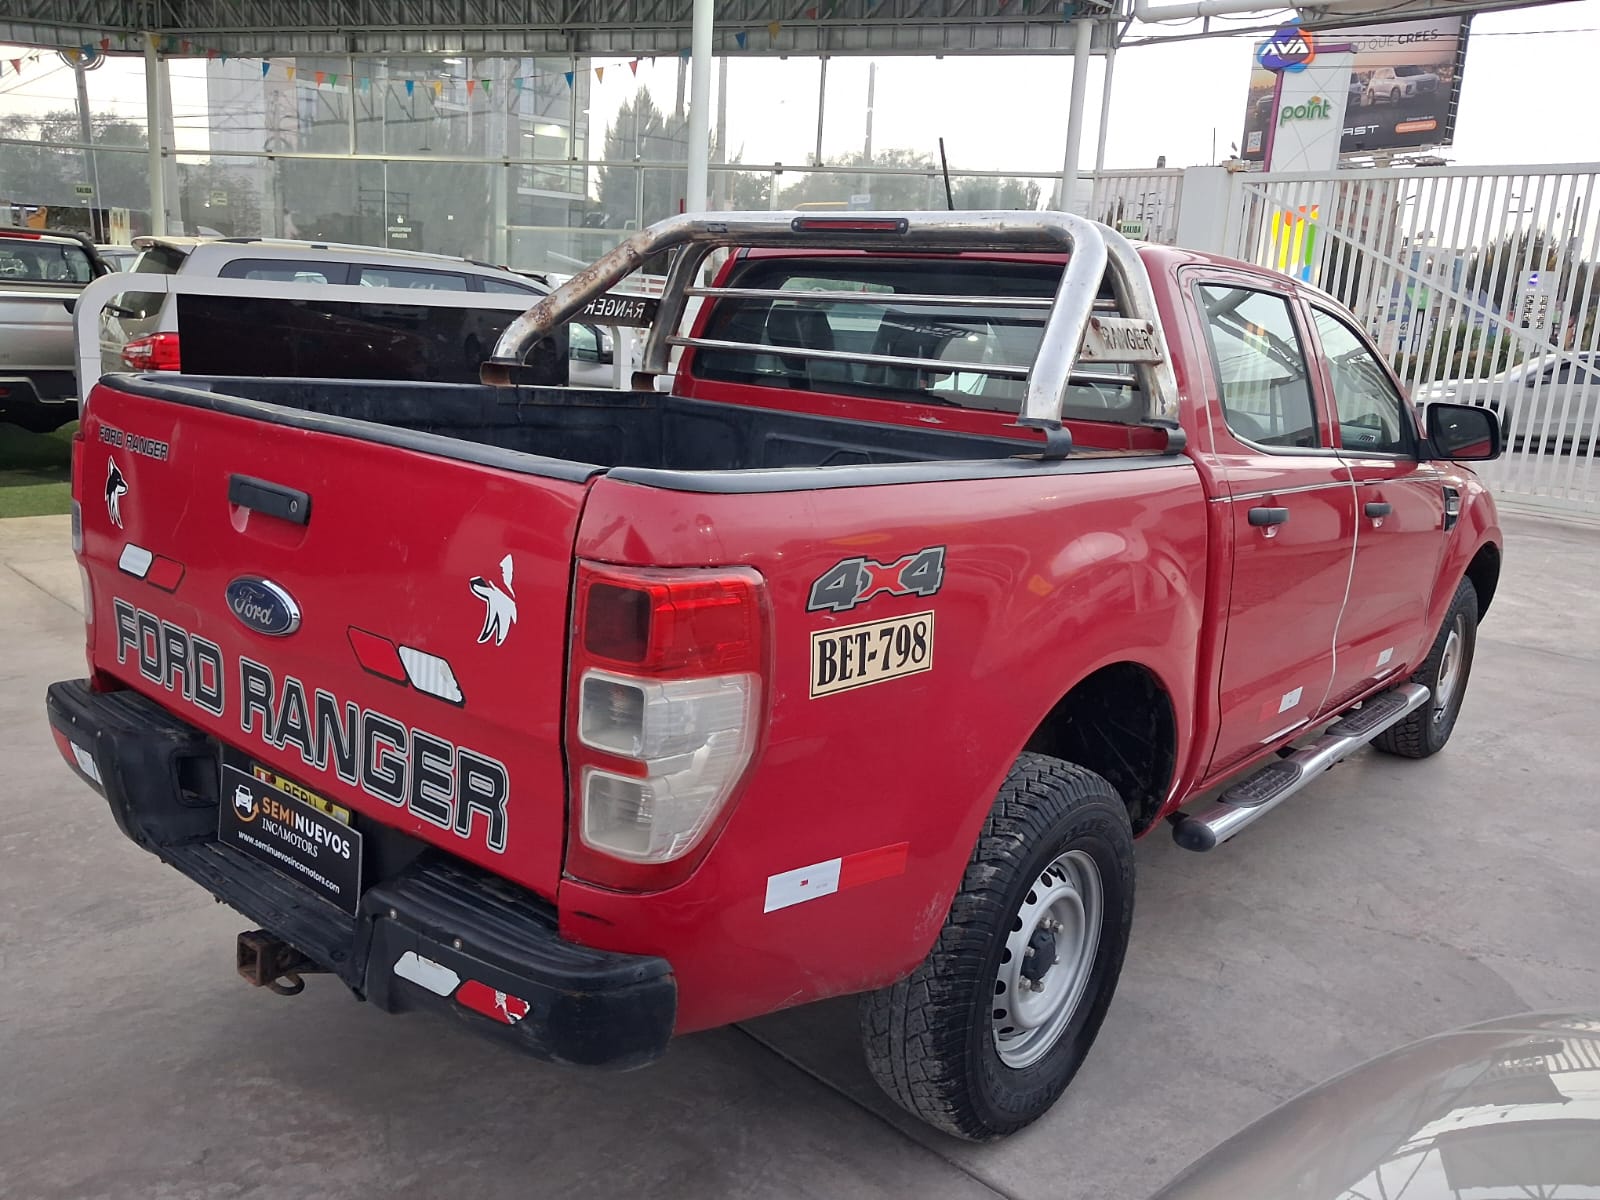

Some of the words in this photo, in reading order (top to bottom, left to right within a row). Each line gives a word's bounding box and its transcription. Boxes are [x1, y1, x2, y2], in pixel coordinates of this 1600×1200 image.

[1260, 39, 1310, 55] AVA
[1397, 28, 1439, 46] CREES
[1280, 97, 1331, 127] point
[1122, 225, 1142, 233] SALIDA
[1101, 326, 1152, 351] RANGER
[99, 423, 124, 449] FORD
[125, 432, 169, 462] RANGER
[235, 585, 275, 625] Ford
[816, 620, 928, 687] BET-798
[113, 596, 225, 718] FORD
[239, 655, 510, 855] RANGER
[262, 796, 351, 860] SEMINUEVOS
[262, 817, 318, 858] INCAMOTORS
[238, 830, 341, 895] www.seminuevosincamotors.com
